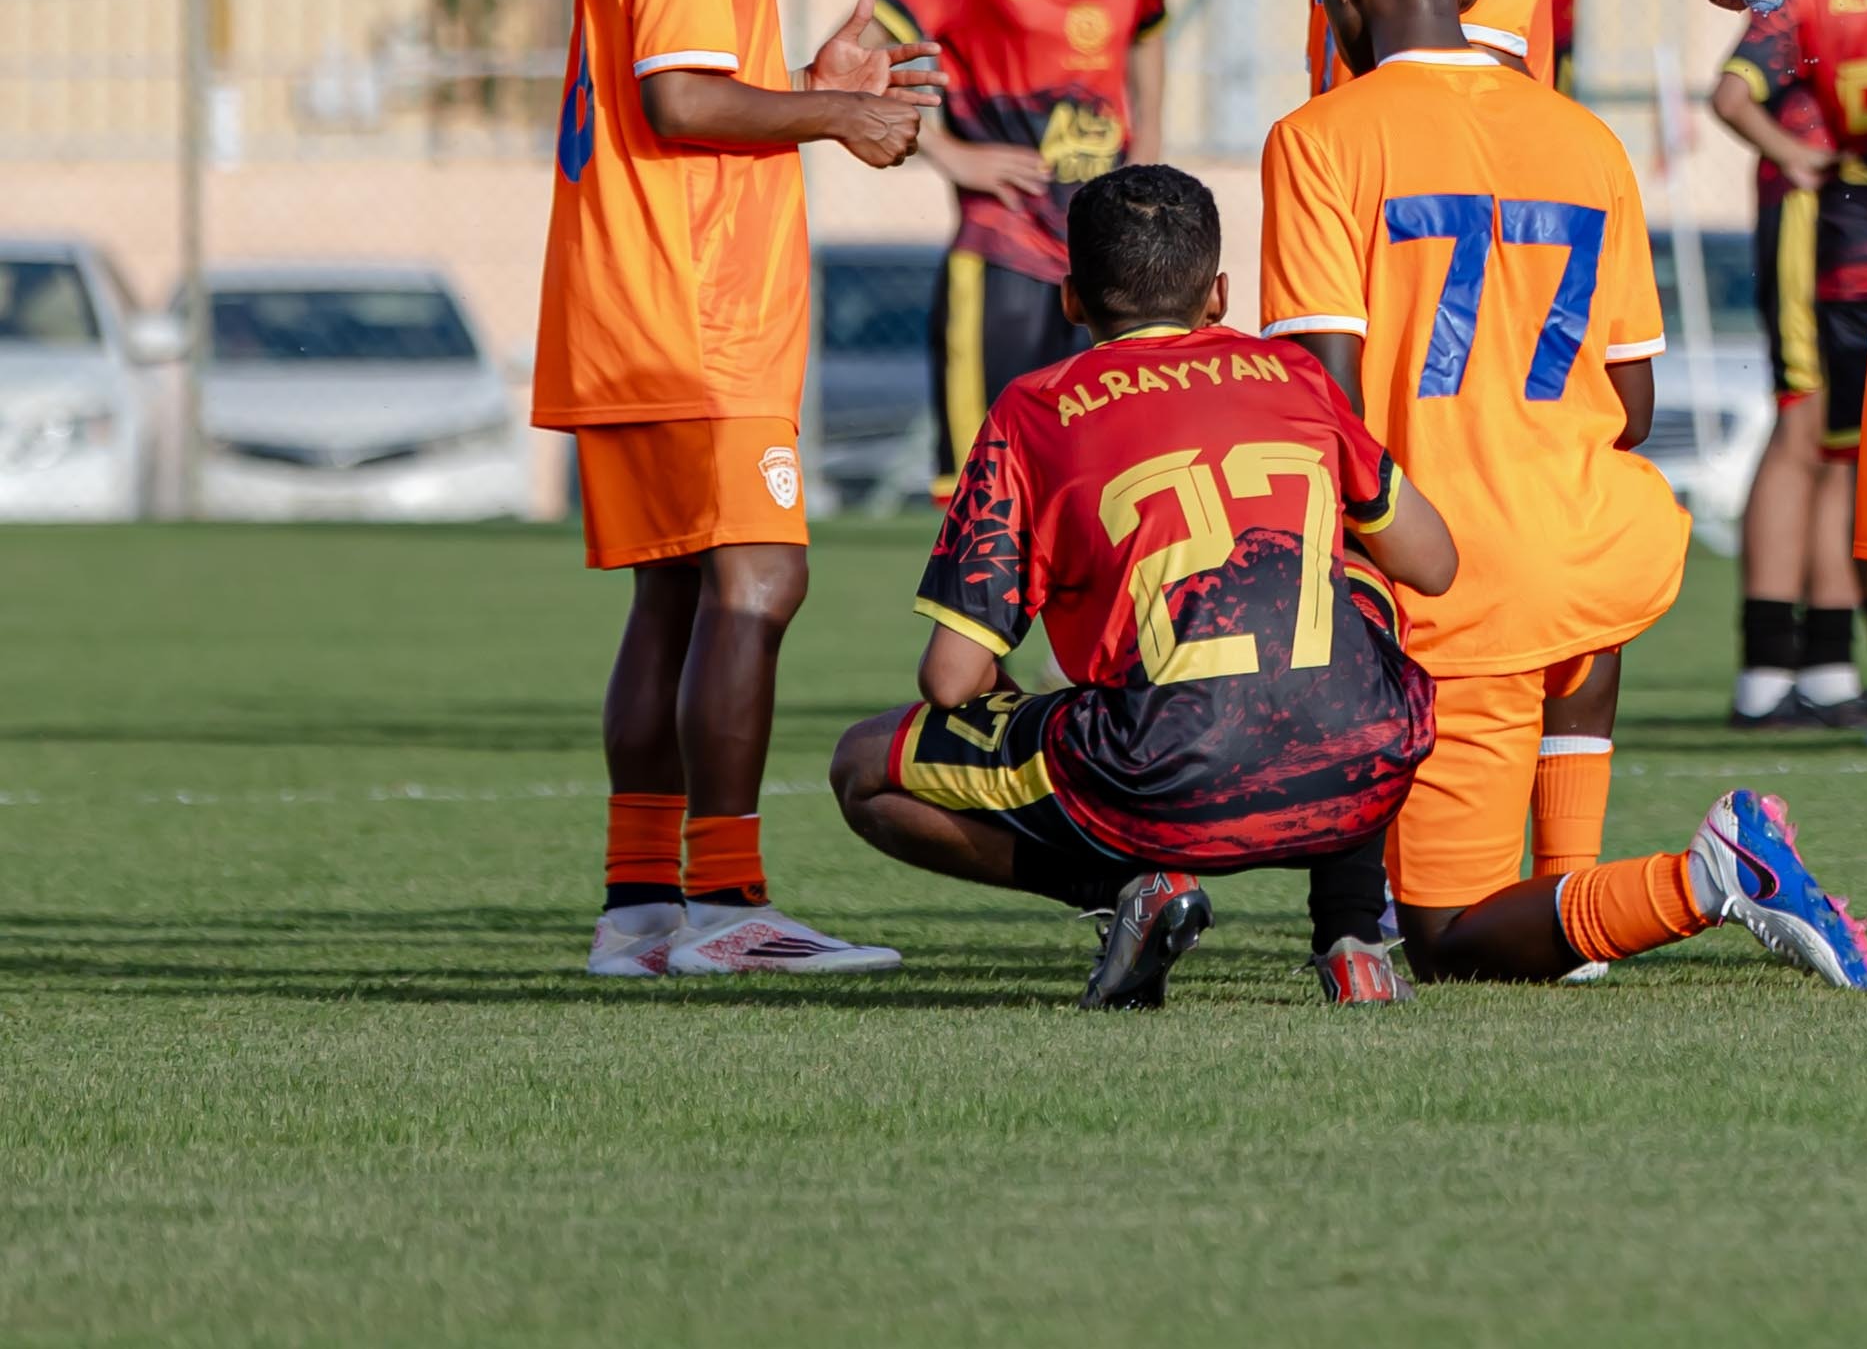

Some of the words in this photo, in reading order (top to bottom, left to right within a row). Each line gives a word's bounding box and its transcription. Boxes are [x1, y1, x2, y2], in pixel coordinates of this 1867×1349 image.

[1057, 353, 1289, 427] ALRAYYAN
[1384, 194, 1608, 401] 77
[1098, 441, 1338, 687] 27
